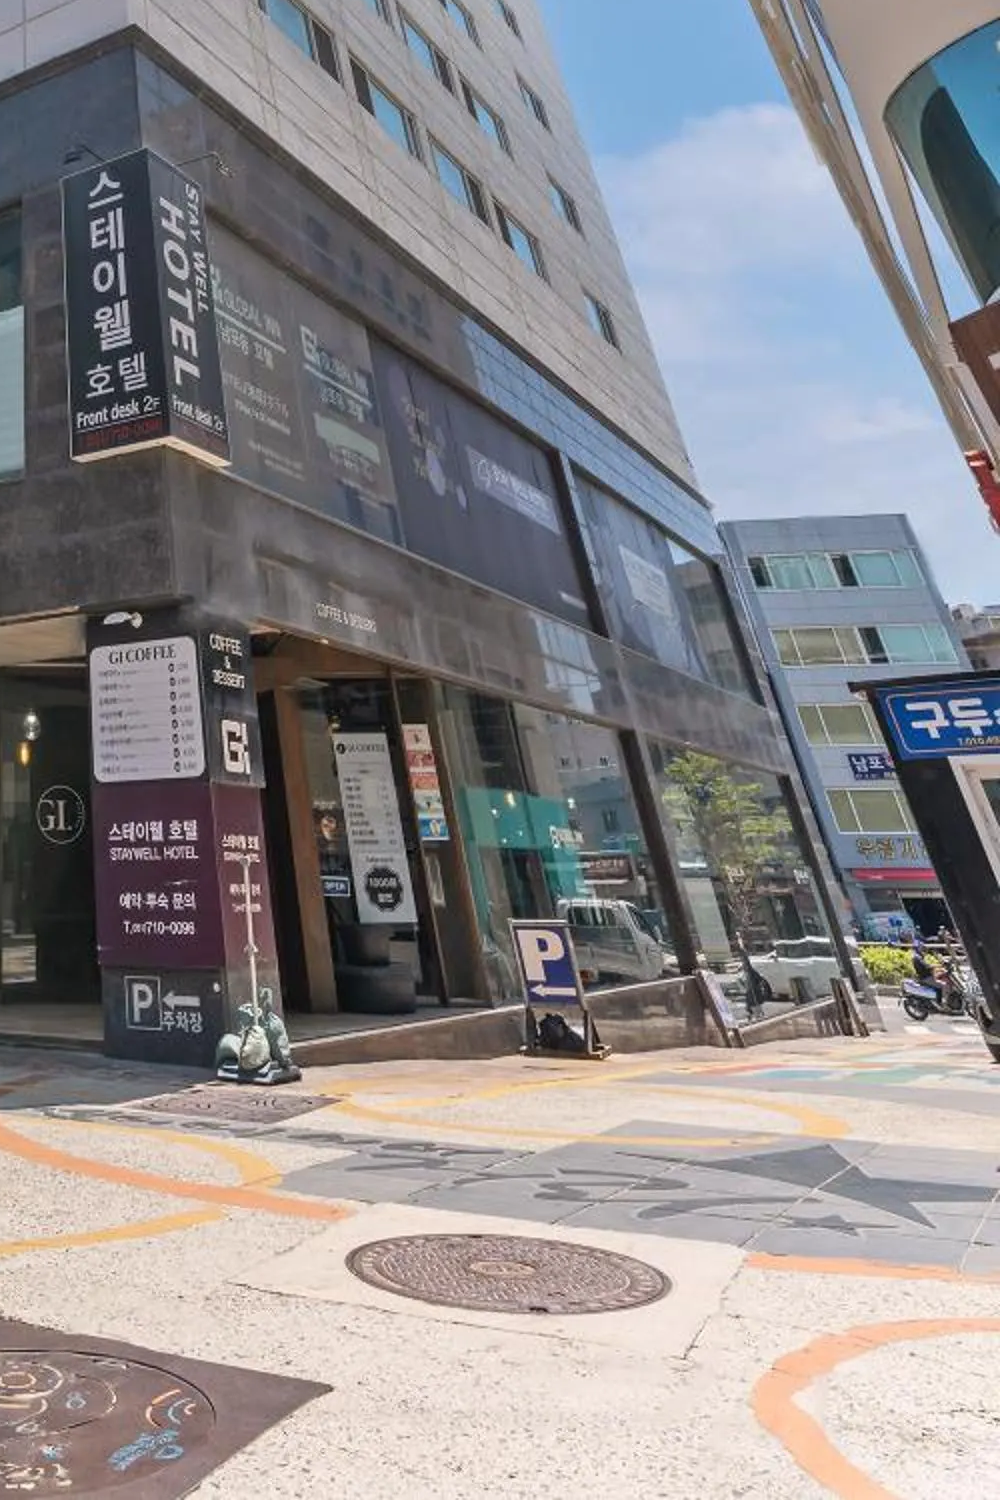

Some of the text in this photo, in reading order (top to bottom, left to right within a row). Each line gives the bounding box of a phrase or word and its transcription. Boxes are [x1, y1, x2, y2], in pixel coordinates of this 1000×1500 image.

[88, 169, 135, 353] 스테이웰
[185, 182, 209, 314] STAY WELL
[158, 195, 202, 387] HOTEL
[85, 350, 150, 400] 호텔
[77, 405, 109, 429] Front
[110, 396, 141, 419] desk
[125, 643, 177, 664] COFFEE
[209, 632, 243, 656] COFFEE
[212, 669, 246, 689] DESSERT
[905, 698, 1000, 739] 구두
[108, 819, 199, 841] 스테이웰 호텔
[110, 845, 199, 861] STAYWELL HOTEL
[172, 891, 197, 911] 문의
[516, 929, 565, 981] P
[131, 982, 153, 1023] P
[160, 1011, 203, 1033] 주차장
